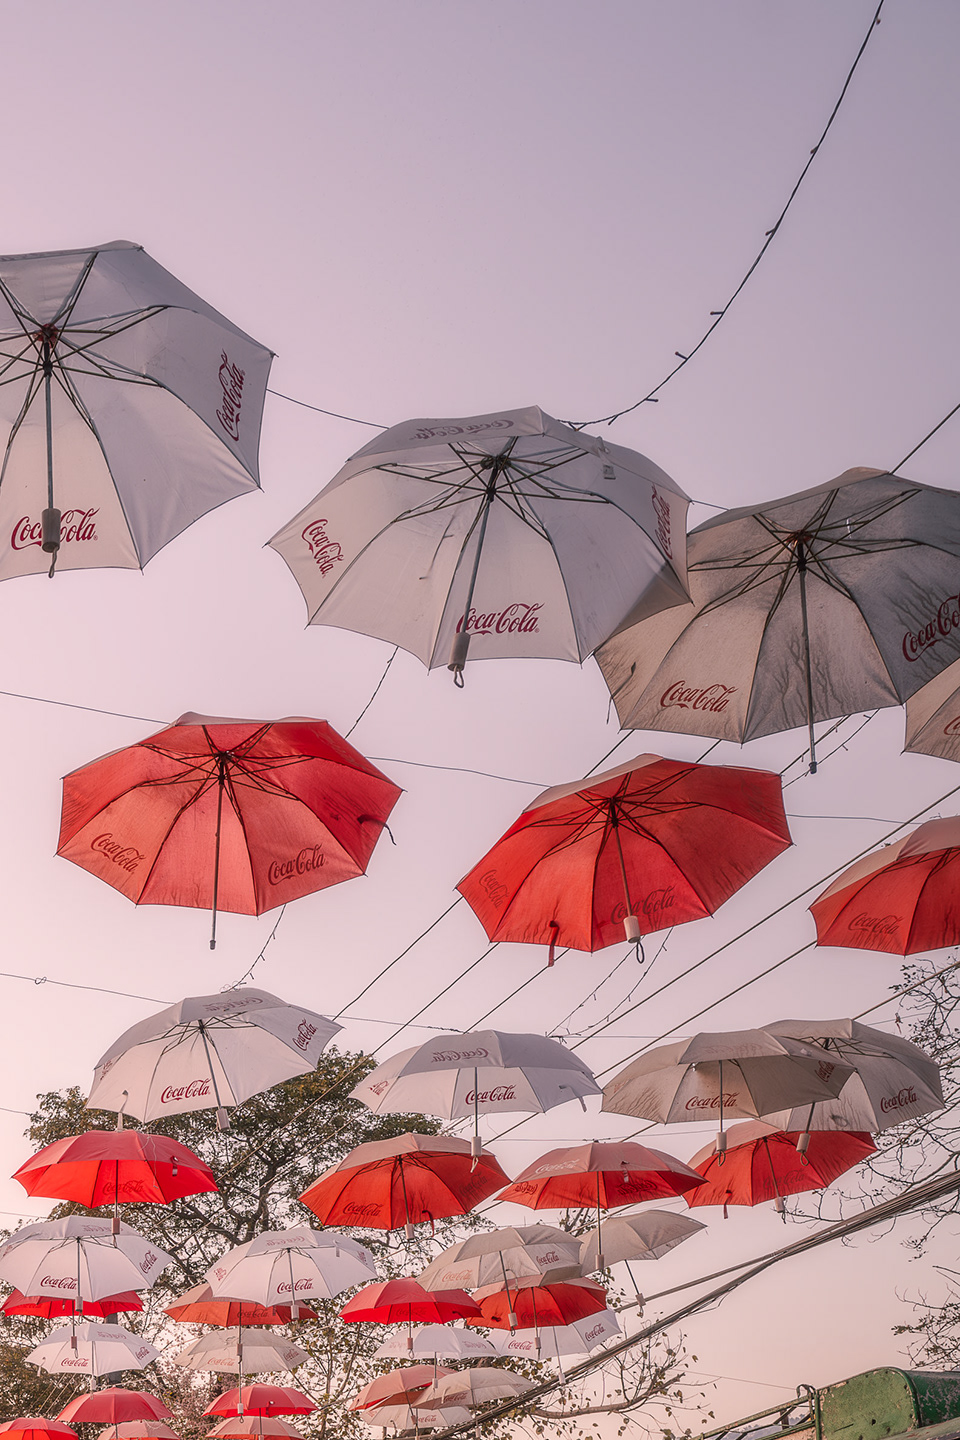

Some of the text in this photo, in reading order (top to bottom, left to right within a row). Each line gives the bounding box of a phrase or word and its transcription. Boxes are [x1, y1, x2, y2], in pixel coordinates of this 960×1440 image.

[216, 347, 246, 442] Coca-Cola
[12, 507, 101, 550] CocCola
[302, 519, 345, 577] Coca-Cola
[456, 603, 546, 636] Coca-Cola
[902, 595, 960, 663] Coca-Co
[659, 681, 739, 714] Coca-Cola
[91, 833, 145, 871] Coca-Cola
[268, 844, 326, 884] Coca-Cola
[848, 913, 903, 935] Coca-Cola
[292, 1019, 319, 1052] Coca-Cola
[161, 1078, 212, 1104] Coca-Cola
[466, 1085, 517, 1105] Coca-Cola
[685, 1092, 739, 1111] Coca-Cola
[881, 1086, 917, 1113] Coca-Cola
[343, 1202, 385, 1217] Coca-Cola
[139, 1251, 158, 1274] Coca-Cola
[40, 1275, 76, 1290] Coca-Cola
[441, 1270, 472, 1282] Coca-Cola
[585, 1323, 606, 1341] Coca-Cola
[508, 1340, 532, 1351] Coca-Cola
[61, 1358, 88, 1368] Coca-Cola
